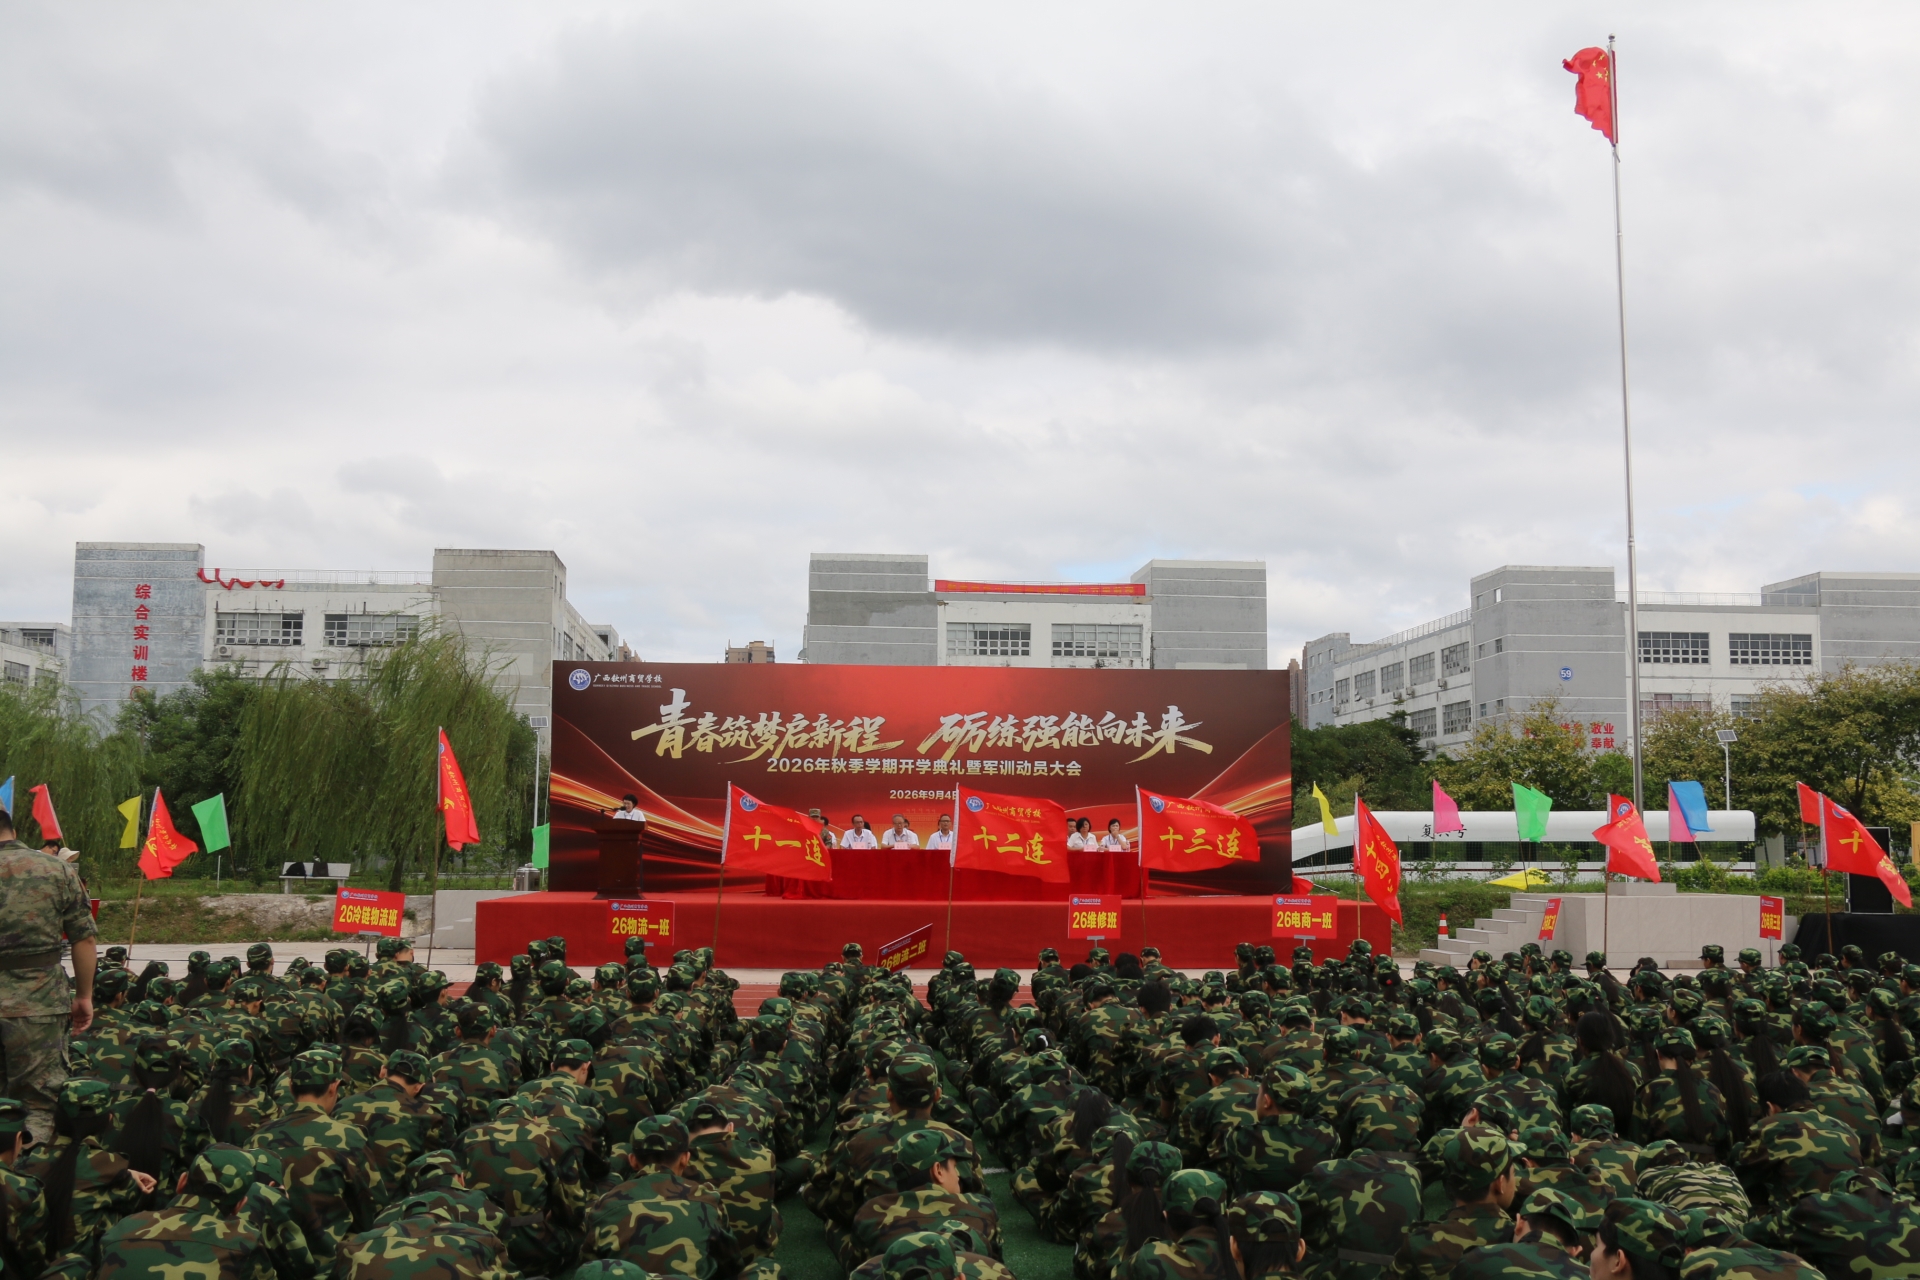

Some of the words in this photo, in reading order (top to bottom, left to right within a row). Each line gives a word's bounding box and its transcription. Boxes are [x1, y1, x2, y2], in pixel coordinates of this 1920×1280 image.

[131, 584, 151, 681] 综合实训楼
[1560, 669, 1572, 678] 59
[631, 688, 905, 764] 青春筑梦启新程
[1591, 737, 1615, 749] 奉献
[767, 757, 1082, 777] 2026年秋季学期开学典礼暨军训动员大会
[743, 825, 826, 867] 十一连
[973, 825, 1052, 865] 十二连
[1159, 826, 1243, 859] 十三连
[339, 904, 398, 927] 26冷链物流班
[1072, 911, 1118, 929] 26维修班
[1276, 911, 1332, 929] 26电商一班
[612, 917, 670, 936] 26物流一班
